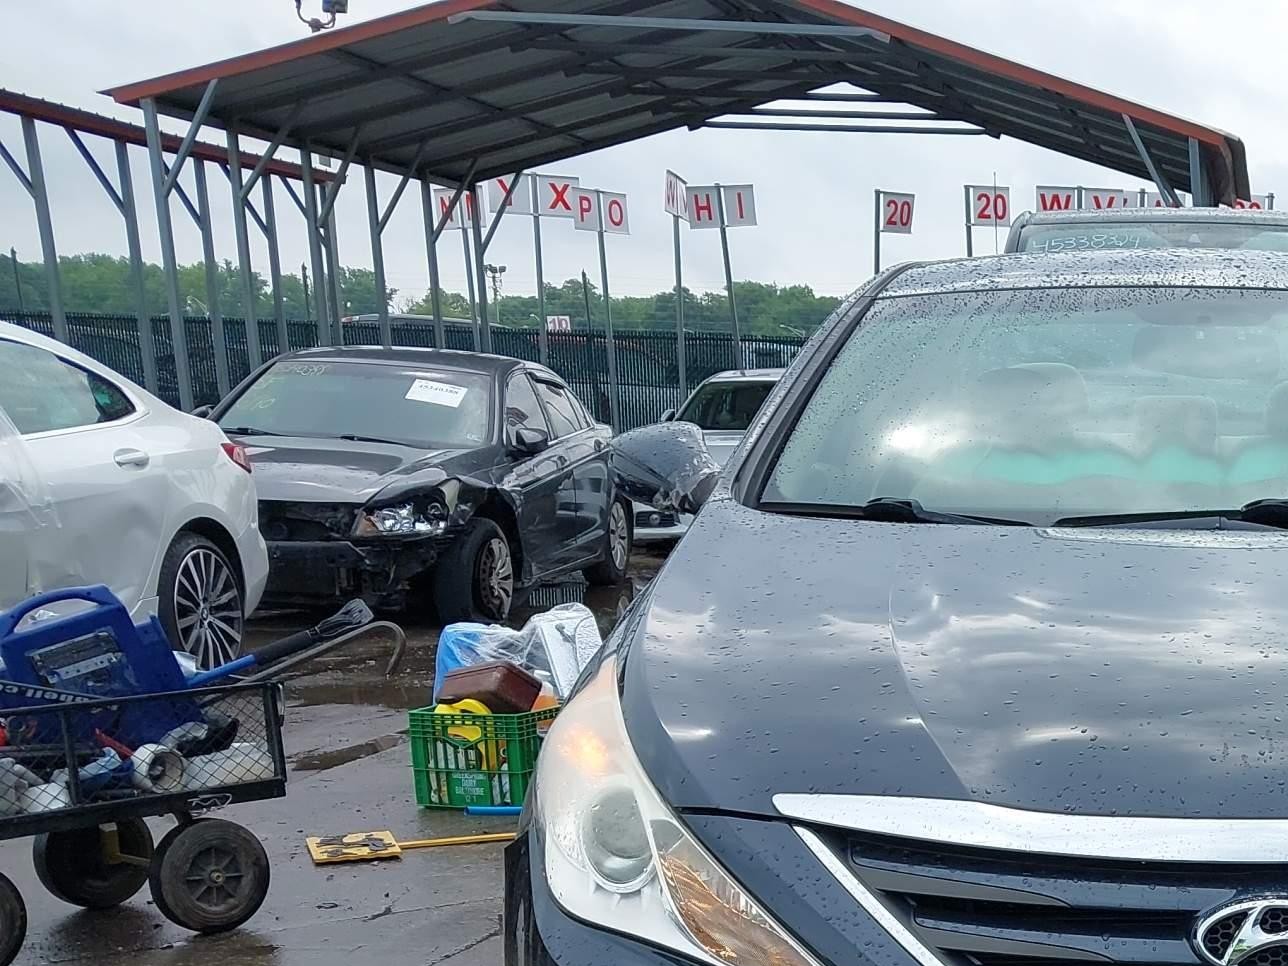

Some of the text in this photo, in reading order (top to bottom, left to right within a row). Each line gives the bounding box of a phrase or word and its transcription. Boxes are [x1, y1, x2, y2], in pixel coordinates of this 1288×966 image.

[548, 183, 572, 211] X
[579, 195, 592, 222] P
[694, 191, 744, 221] H I
[976, 192, 1007, 220] 20
[1040, 193, 1072, 210] W
[886, 199, 911, 226] 20
